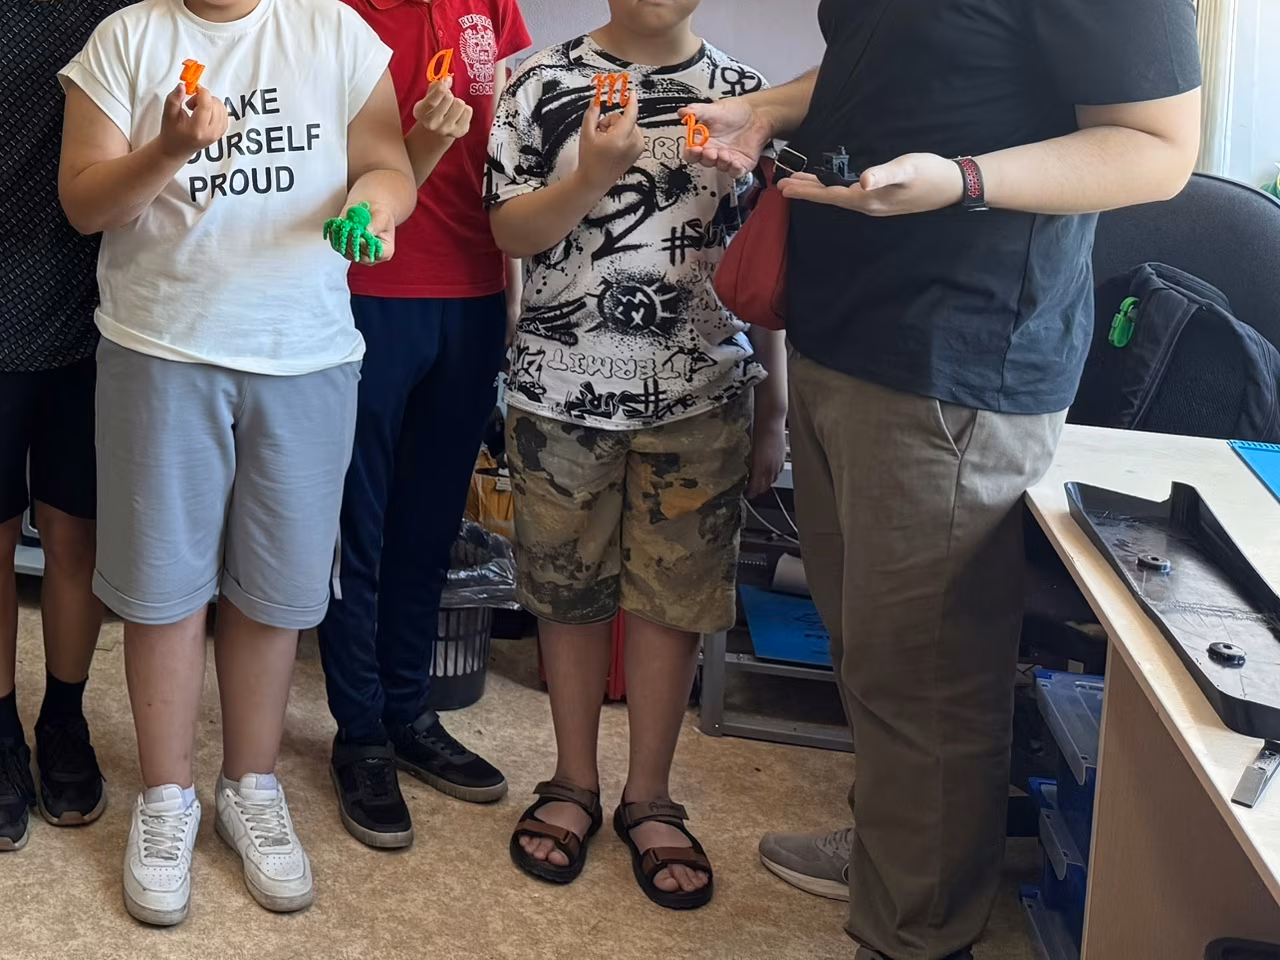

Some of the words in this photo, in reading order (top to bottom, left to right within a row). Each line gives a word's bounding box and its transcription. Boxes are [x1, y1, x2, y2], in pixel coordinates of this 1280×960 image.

[459, 15, 492, 27] RUSSIA
[224, 87, 280, 121] AKE
[470, 83, 494, 95] SOCH
[186, 123, 320, 164] URSELF
[189, 166, 295, 202] PROUD
